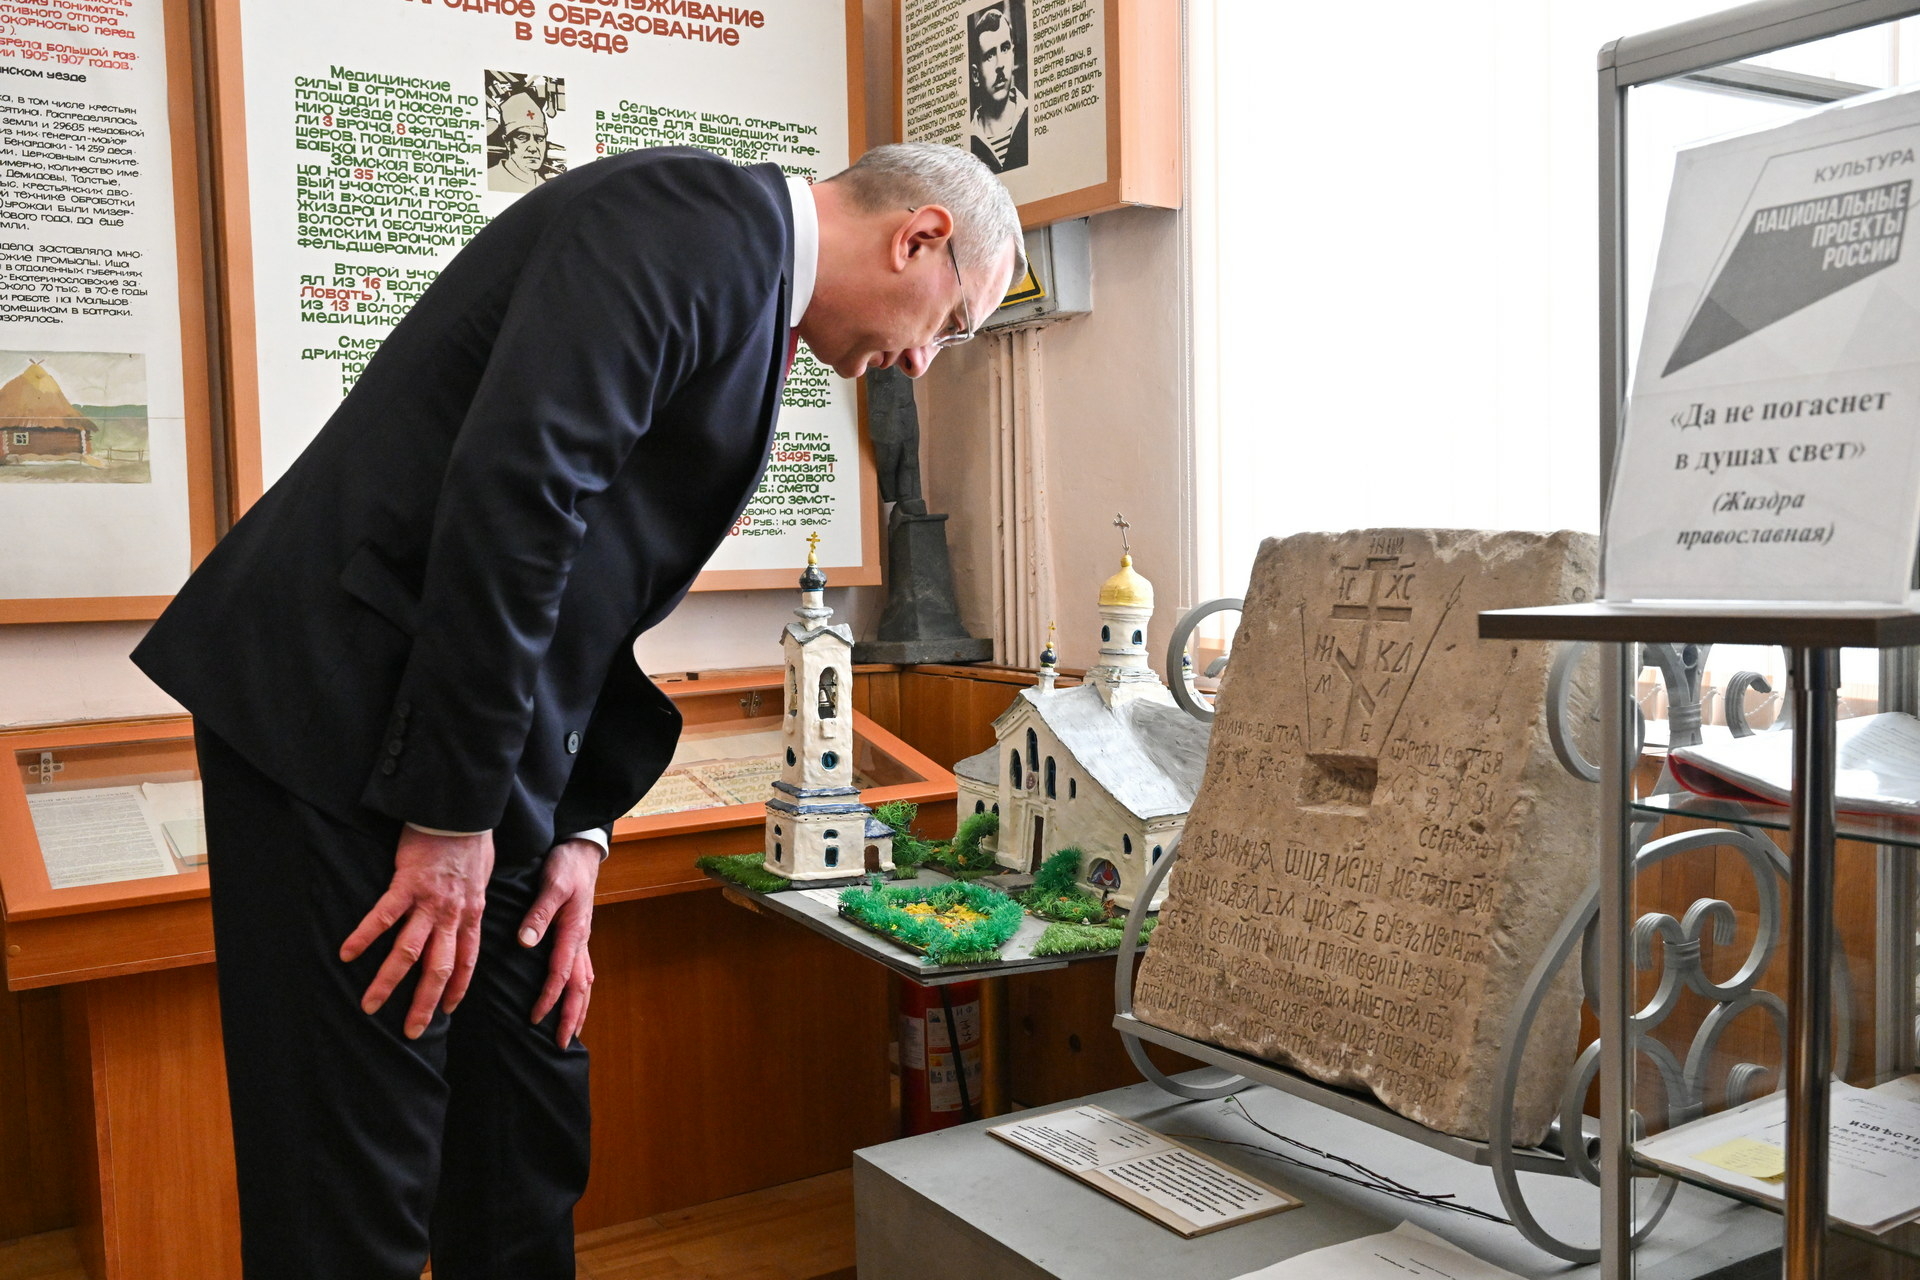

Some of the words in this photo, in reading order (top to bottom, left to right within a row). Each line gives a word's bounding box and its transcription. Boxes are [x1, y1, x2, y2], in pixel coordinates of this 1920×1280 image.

[1814, 148, 1915, 184] КУЛЬТУРА
[1754, 182, 1909, 234] НАЦИОНАЛЬНЫЕ
[1812, 210, 1904, 248] ПРОЕКТЫ
[1822, 236, 1899, 271] РОССИИ
[1724, 404, 1754, 425] не
[1761, 391, 1891, 421] погаснет
[1675, 453, 1688, 470] в
[1694, 445, 1779, 475] душах
